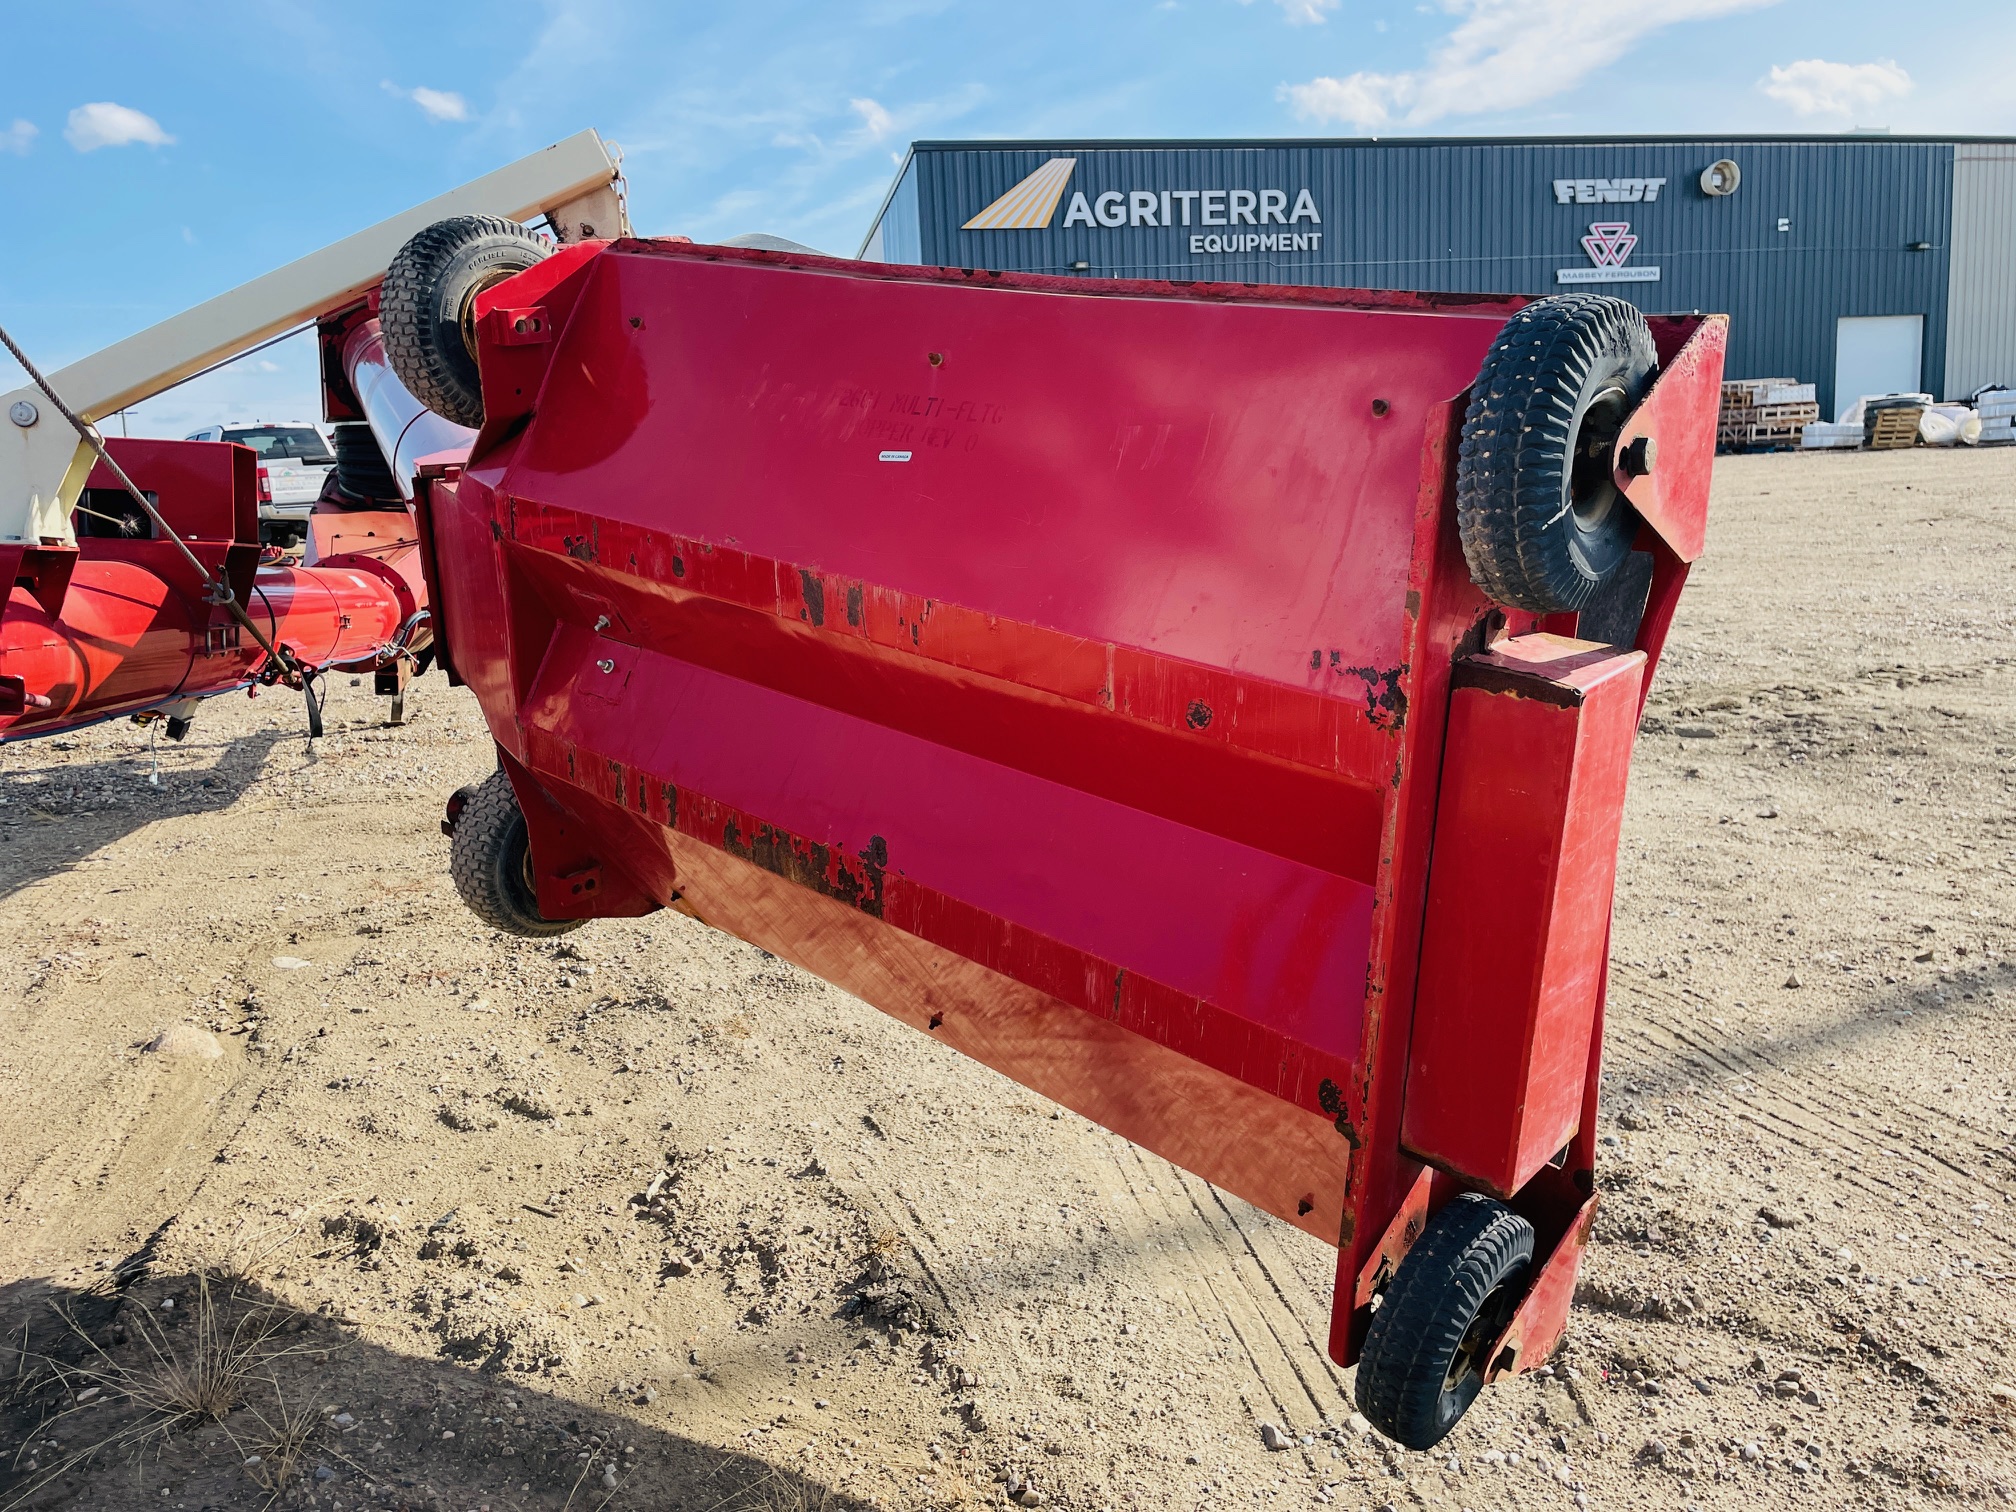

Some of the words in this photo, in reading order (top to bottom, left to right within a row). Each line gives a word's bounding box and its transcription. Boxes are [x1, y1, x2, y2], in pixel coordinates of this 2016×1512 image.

[1553, 178, 1667, 204] FENDT
[1063, 189, 1322, 228] AGRITERRA
[1190, 233, 1323, 254] EQUIPMENT
[1562, 272, 1603, 280] MASSEY
[1605, 270, 1657, 278] FERGUSON
